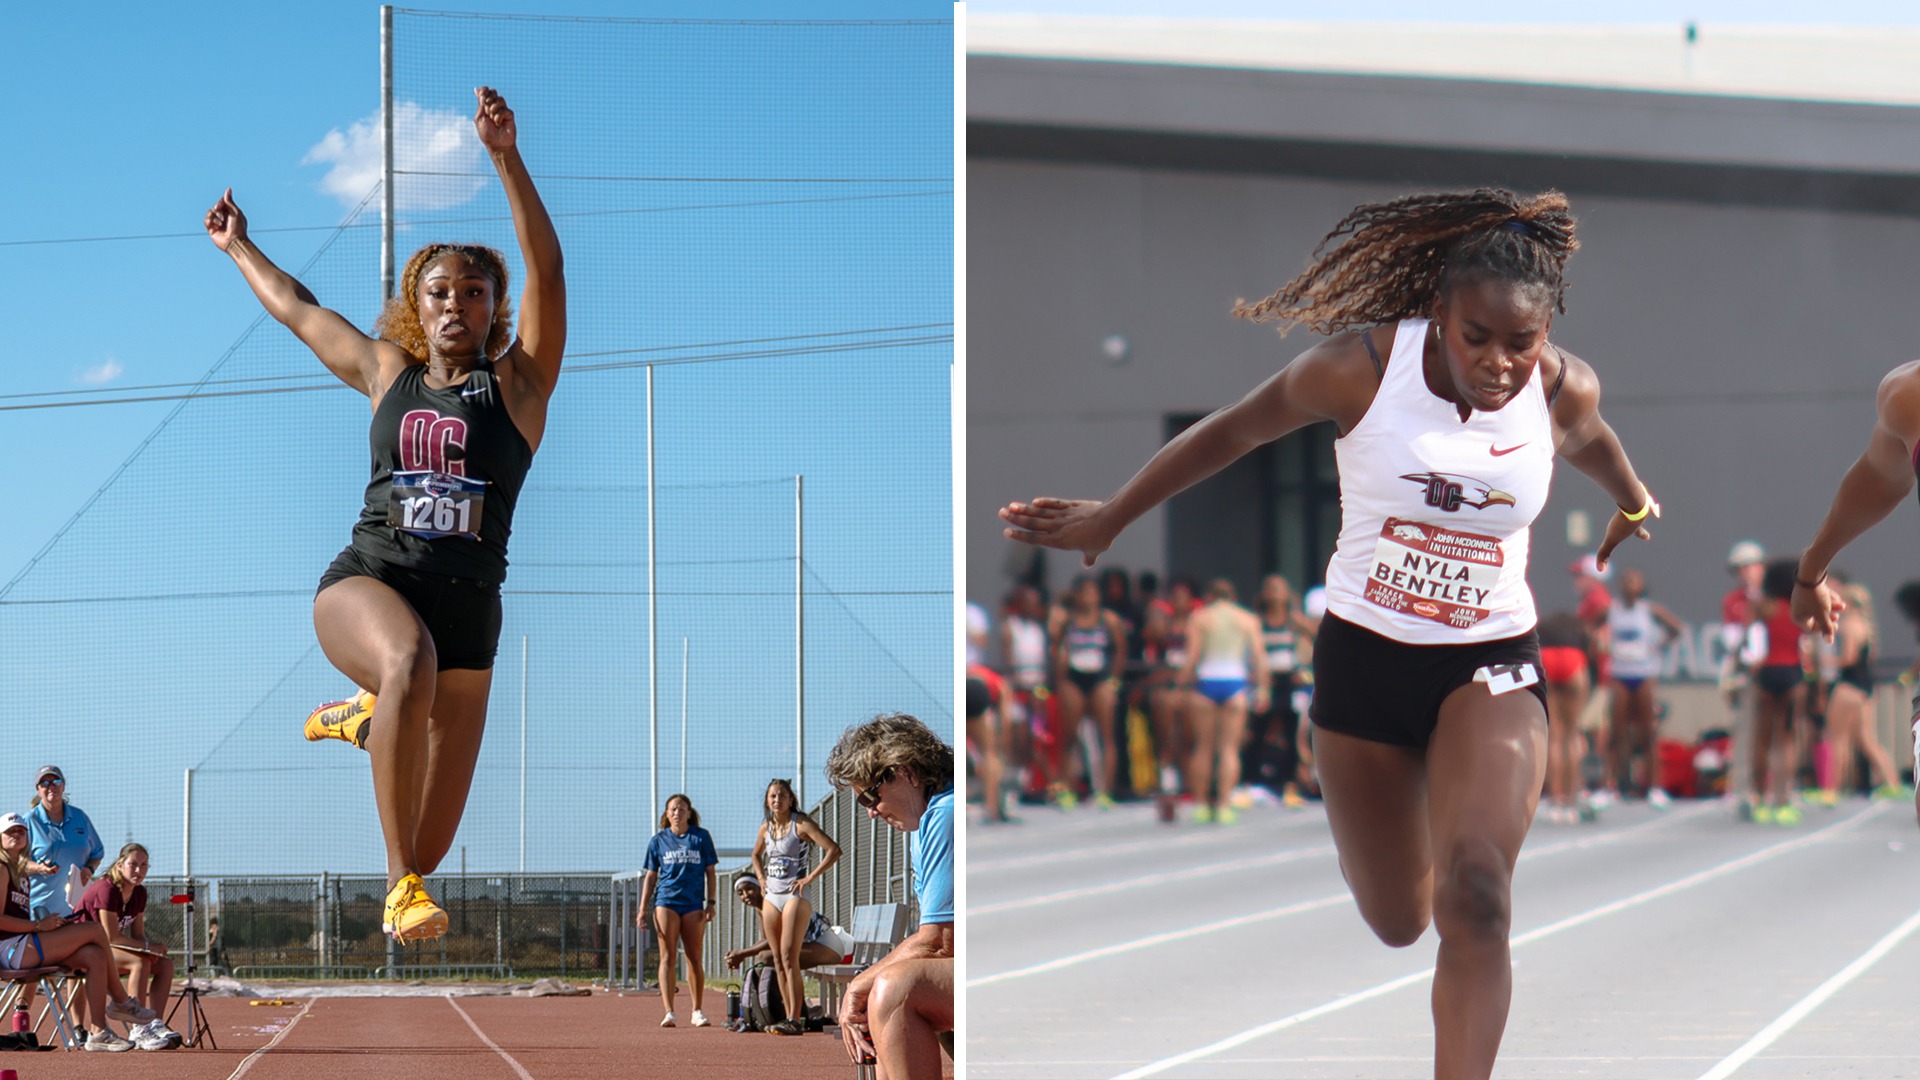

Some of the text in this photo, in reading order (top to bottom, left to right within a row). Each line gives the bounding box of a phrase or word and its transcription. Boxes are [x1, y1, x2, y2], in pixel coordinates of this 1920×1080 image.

[399, 409, 468, 477] OC
[1424, 476, 1463, 513] OC
[400, 496, 471, 532] 1261
[1429, 542, 1497, 562] INVITATIONAL
[1433, 533, 1498, 551] JOHN MCDONNELL
[1403, 552, 1469, 581] NYLA
[1375, 562, 1490, 606] BENTLEY
[1379, 584, 1405, 600] TRACK
[1375, 595, 1401, 610] WORLD
[1455, 607, 1477, 617] JOHN
[320, 700, 367, 727] NITRO
